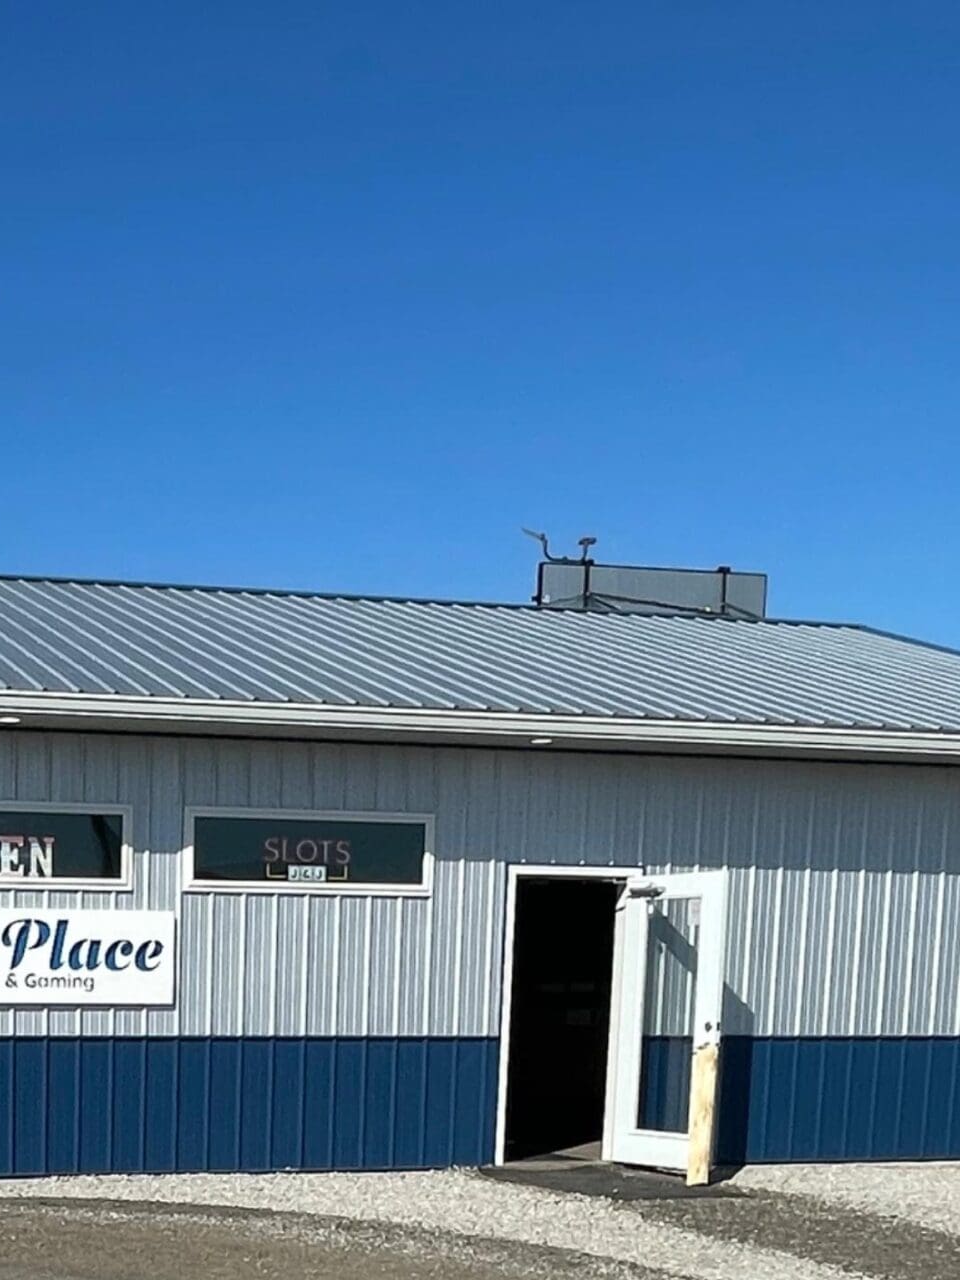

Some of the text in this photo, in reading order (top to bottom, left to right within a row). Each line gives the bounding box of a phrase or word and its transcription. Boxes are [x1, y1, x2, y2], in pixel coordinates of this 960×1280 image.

[264, 839, 351, 864] SLOTS
[1, 918, 165, 972] Place
[5, 973, 18, 988] &
[24, 973, 96, 993] Gaming
